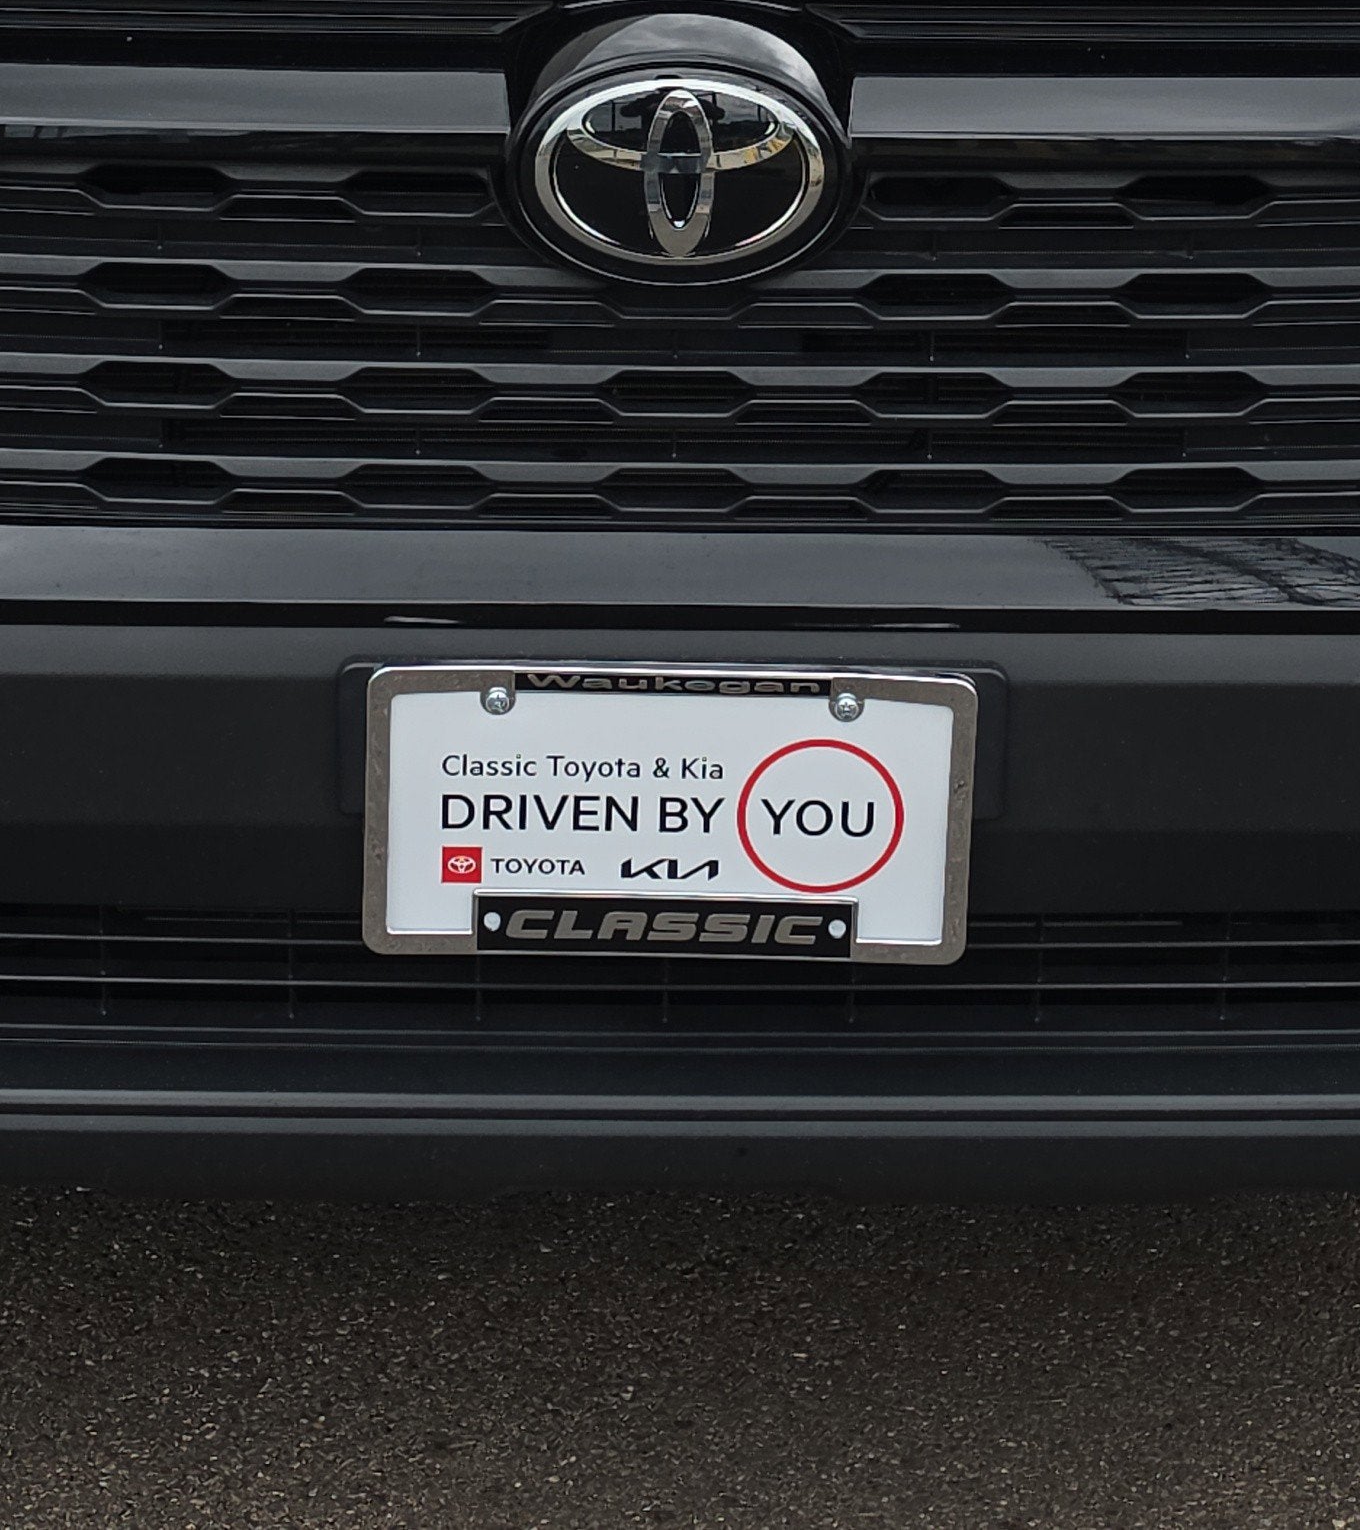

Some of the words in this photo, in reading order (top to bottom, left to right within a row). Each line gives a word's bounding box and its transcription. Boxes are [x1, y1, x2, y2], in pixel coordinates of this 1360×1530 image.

[441, 753, 538, 778] Classic
[545, 754, 641, 783] Toyota
[652, 756, 671, 779] &
[681, 756, 724, 780] Kia
[441, 793, 639, 832] DRIVEN
[658, 796, 726, 834] BY
[760, 798, 876, 838] YOU
[490, 857, 586, 876] TOYOTA
[620, 858, 720, 881] KIA
[505, 908, 824, 945] CLASSIC
